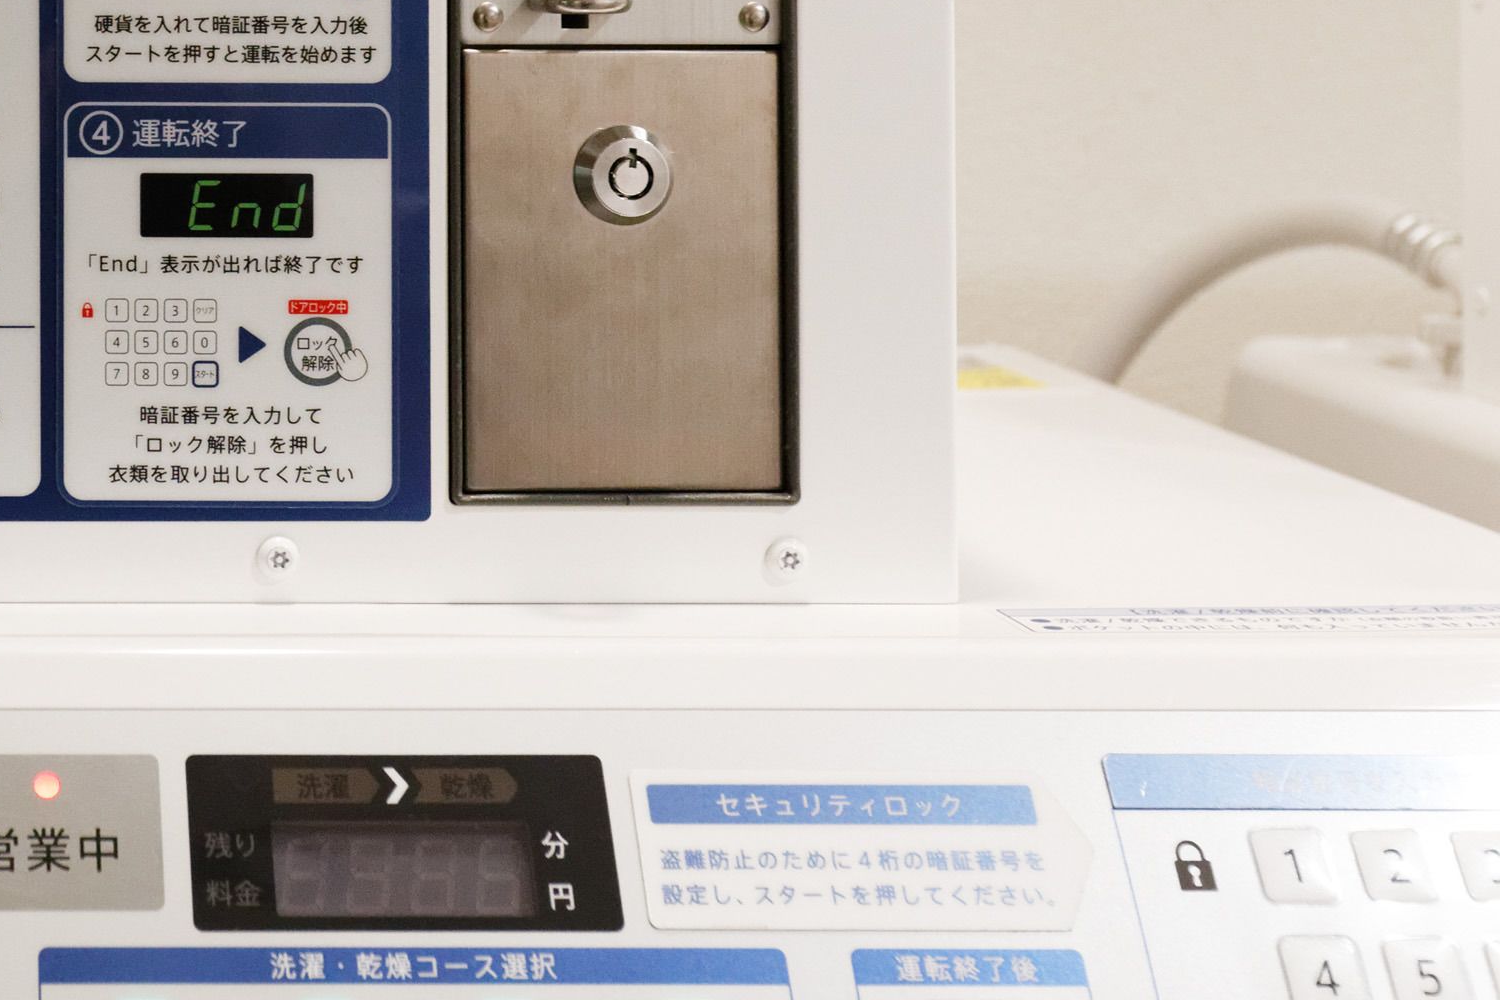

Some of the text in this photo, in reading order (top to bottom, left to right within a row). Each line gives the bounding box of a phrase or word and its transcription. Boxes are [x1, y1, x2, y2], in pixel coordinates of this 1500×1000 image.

[95, 15, 367, 34] 硬貨を入れて暗証番号を入力後
[87, 45, 376, 64] スタートを押すと運転を始めます
[133, 119, 246, 147] 運転終了
[188, 180, 307, 231] End
[289, 302, 347, 313] ドアロック中
[201, 337, 209, 348] 0
[140, 406, 321, 424] 暗証番号を入力して
[136, 435, 326, 454] 「ロック解除」を押し
[109, 465, 353, 483] 衣類を取り出してください
[716, 794, 962, 817] セキュリティロック
[542, 832, 568, 859] 分
[1284, 849, 1302, 882] 1
[549, 883, 575, 910] 円
[270, 953, 557, 980] 洗濯・乾燥コース選択
[896, 956, 1038, 983] 運転終了後
[1316, 960, 1442, 996] 4 5
